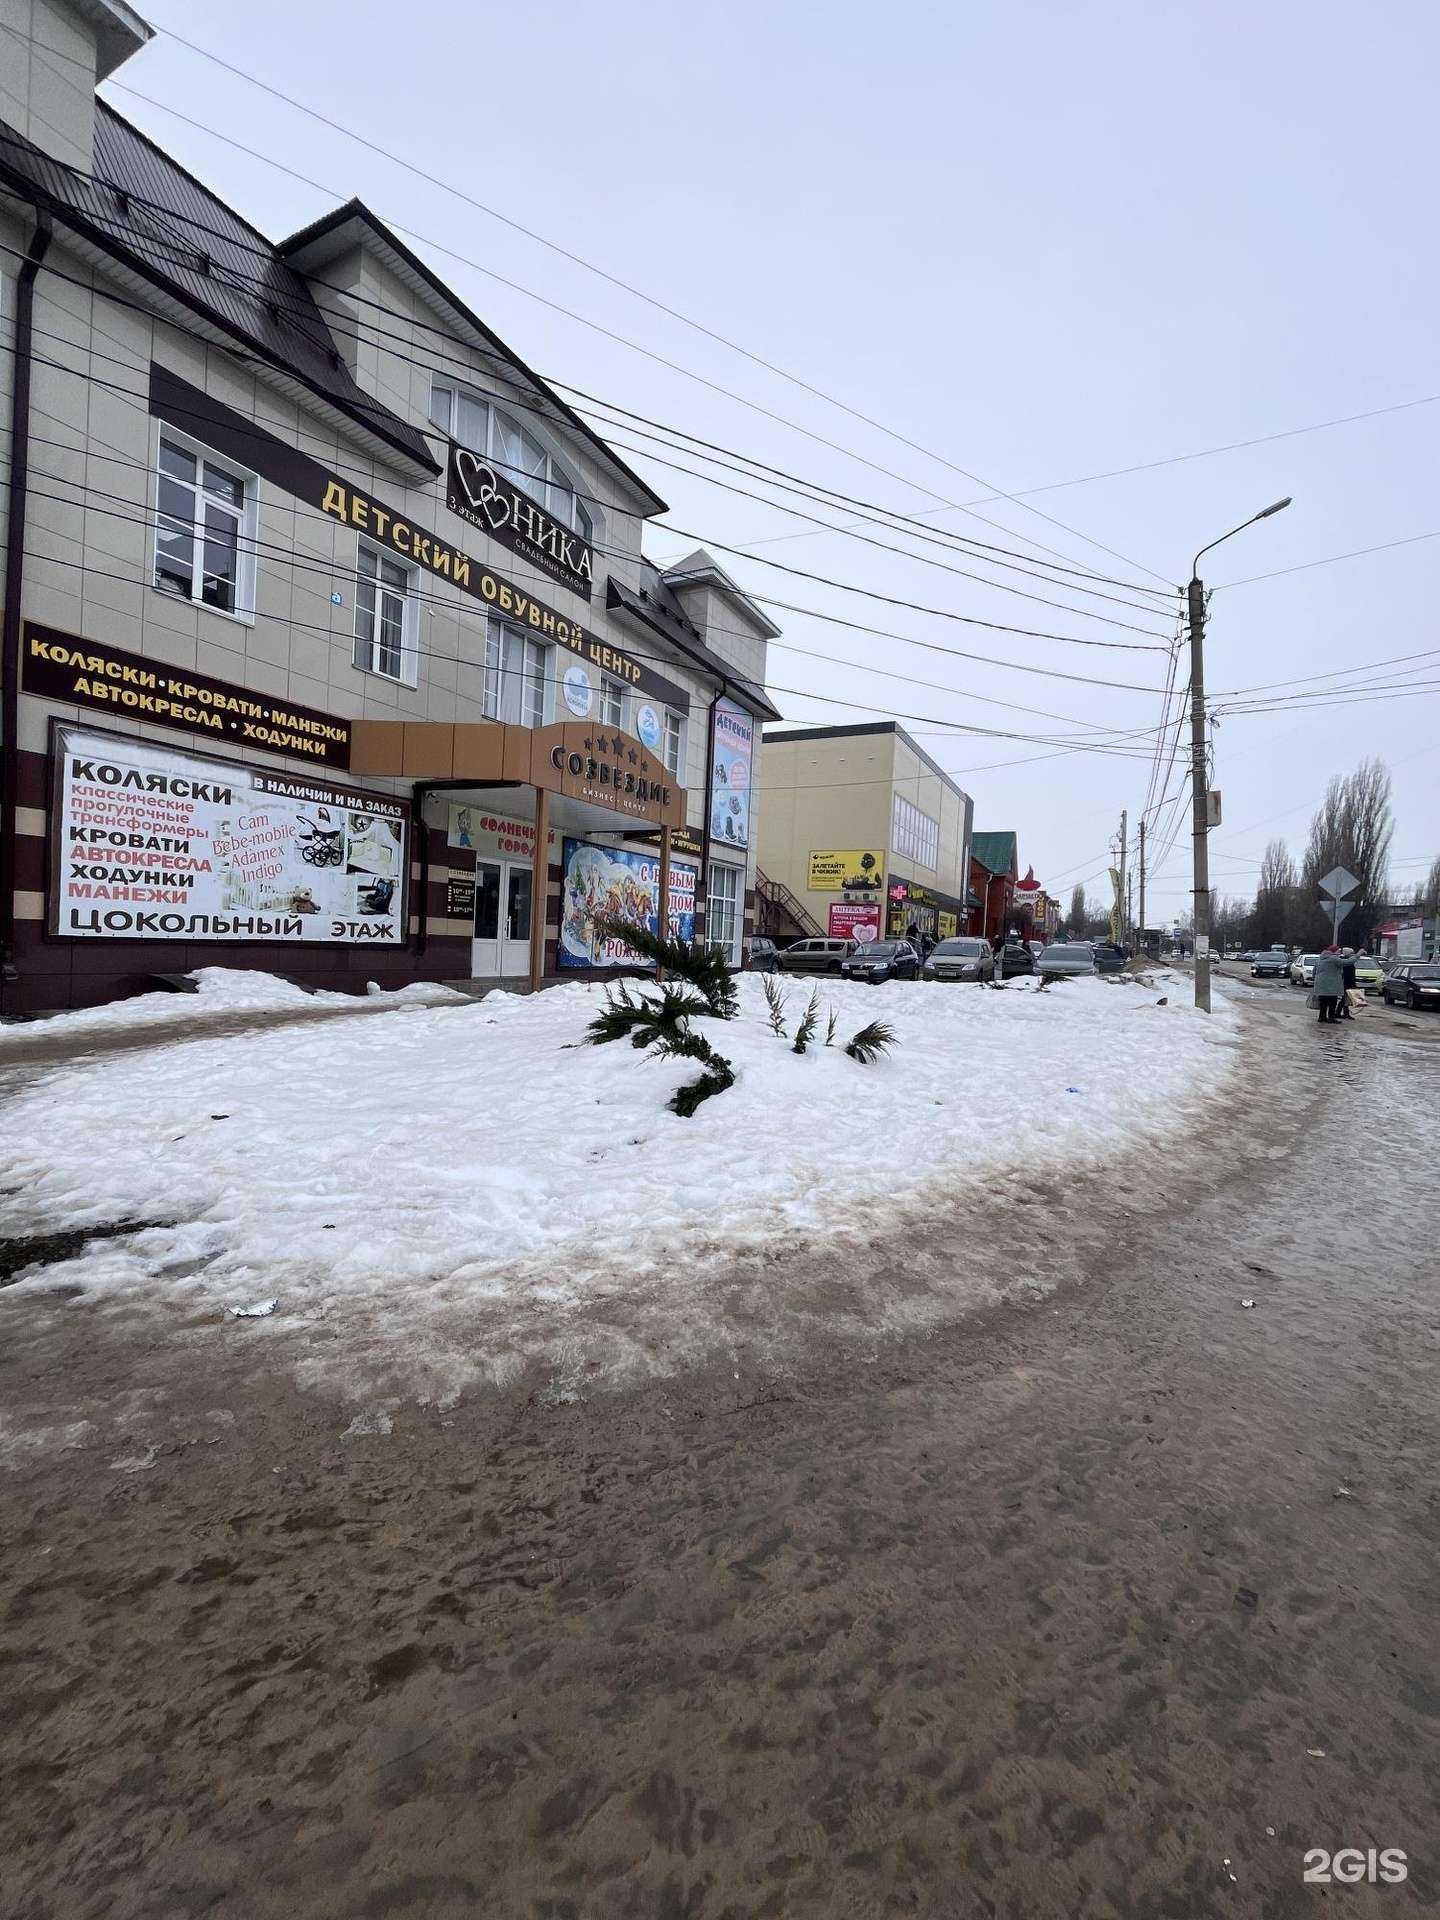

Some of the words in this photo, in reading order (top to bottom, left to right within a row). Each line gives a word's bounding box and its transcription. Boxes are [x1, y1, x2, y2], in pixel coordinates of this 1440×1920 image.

[449, 495, 457, 510] 3
[458, 505, 485, 529] этаж
[510, 493, 593, 584] НИКА
[516, 539, 559, 574] СВАДЕБНЫЙ
[560, 569, 584, 591] САЛОН
[322, 480, 470, 587] ДЕТСКИЙ
[481, 575, 583, 651] ОБУВНОЙ
[589, 643, 641, 682] ЦЕНТР
[31, 639, 155, 688] КОЛЯСКИ
[168, 679, 262, 719] КРОВАТИ
[271, 709, 347, 743] МАНЕЖИ
[73, 677, 223, 730] АВТОКРЕСЛА
[243, 722, 326, 756] ХОДУНКИ
[72, 758, 232, 806] КОЛЯСКИ
[550, 745, 672, 806] СОЗВЕЗДИЕ
[71, 784, 195, 813] классические
[71, 797, 189, 824] прогулочные
[254, 777, 264, 789] В
[267, 780, 332, 802] НАЛИЧИИ
[335, 794, 344, 806] И
[347, 796, 363, 809] НА
[365, 800, 402, 817] ЗАКАЗ
[70, 810, 209, 839] трансформеры
[238, 815, 269, 831] Cam
[69, 826, 190, 854] КРОВАТИ
[70, 845, 213, 873] АВТОКРЕСЛА
[230, 845, 285, 869] Adamex
[70, 863, 194, 888] ХОДУНКИ
[241, 862, 283, 884] Indigo
[653, 867, 695, 889] НВЫМ
[68, 882, 188, 905] МАНЕЖИ
[70, 908, 303, 935] ЦОКОЛЬНЫЙ
[331, 921, 395, 939] ЭТАЖ
